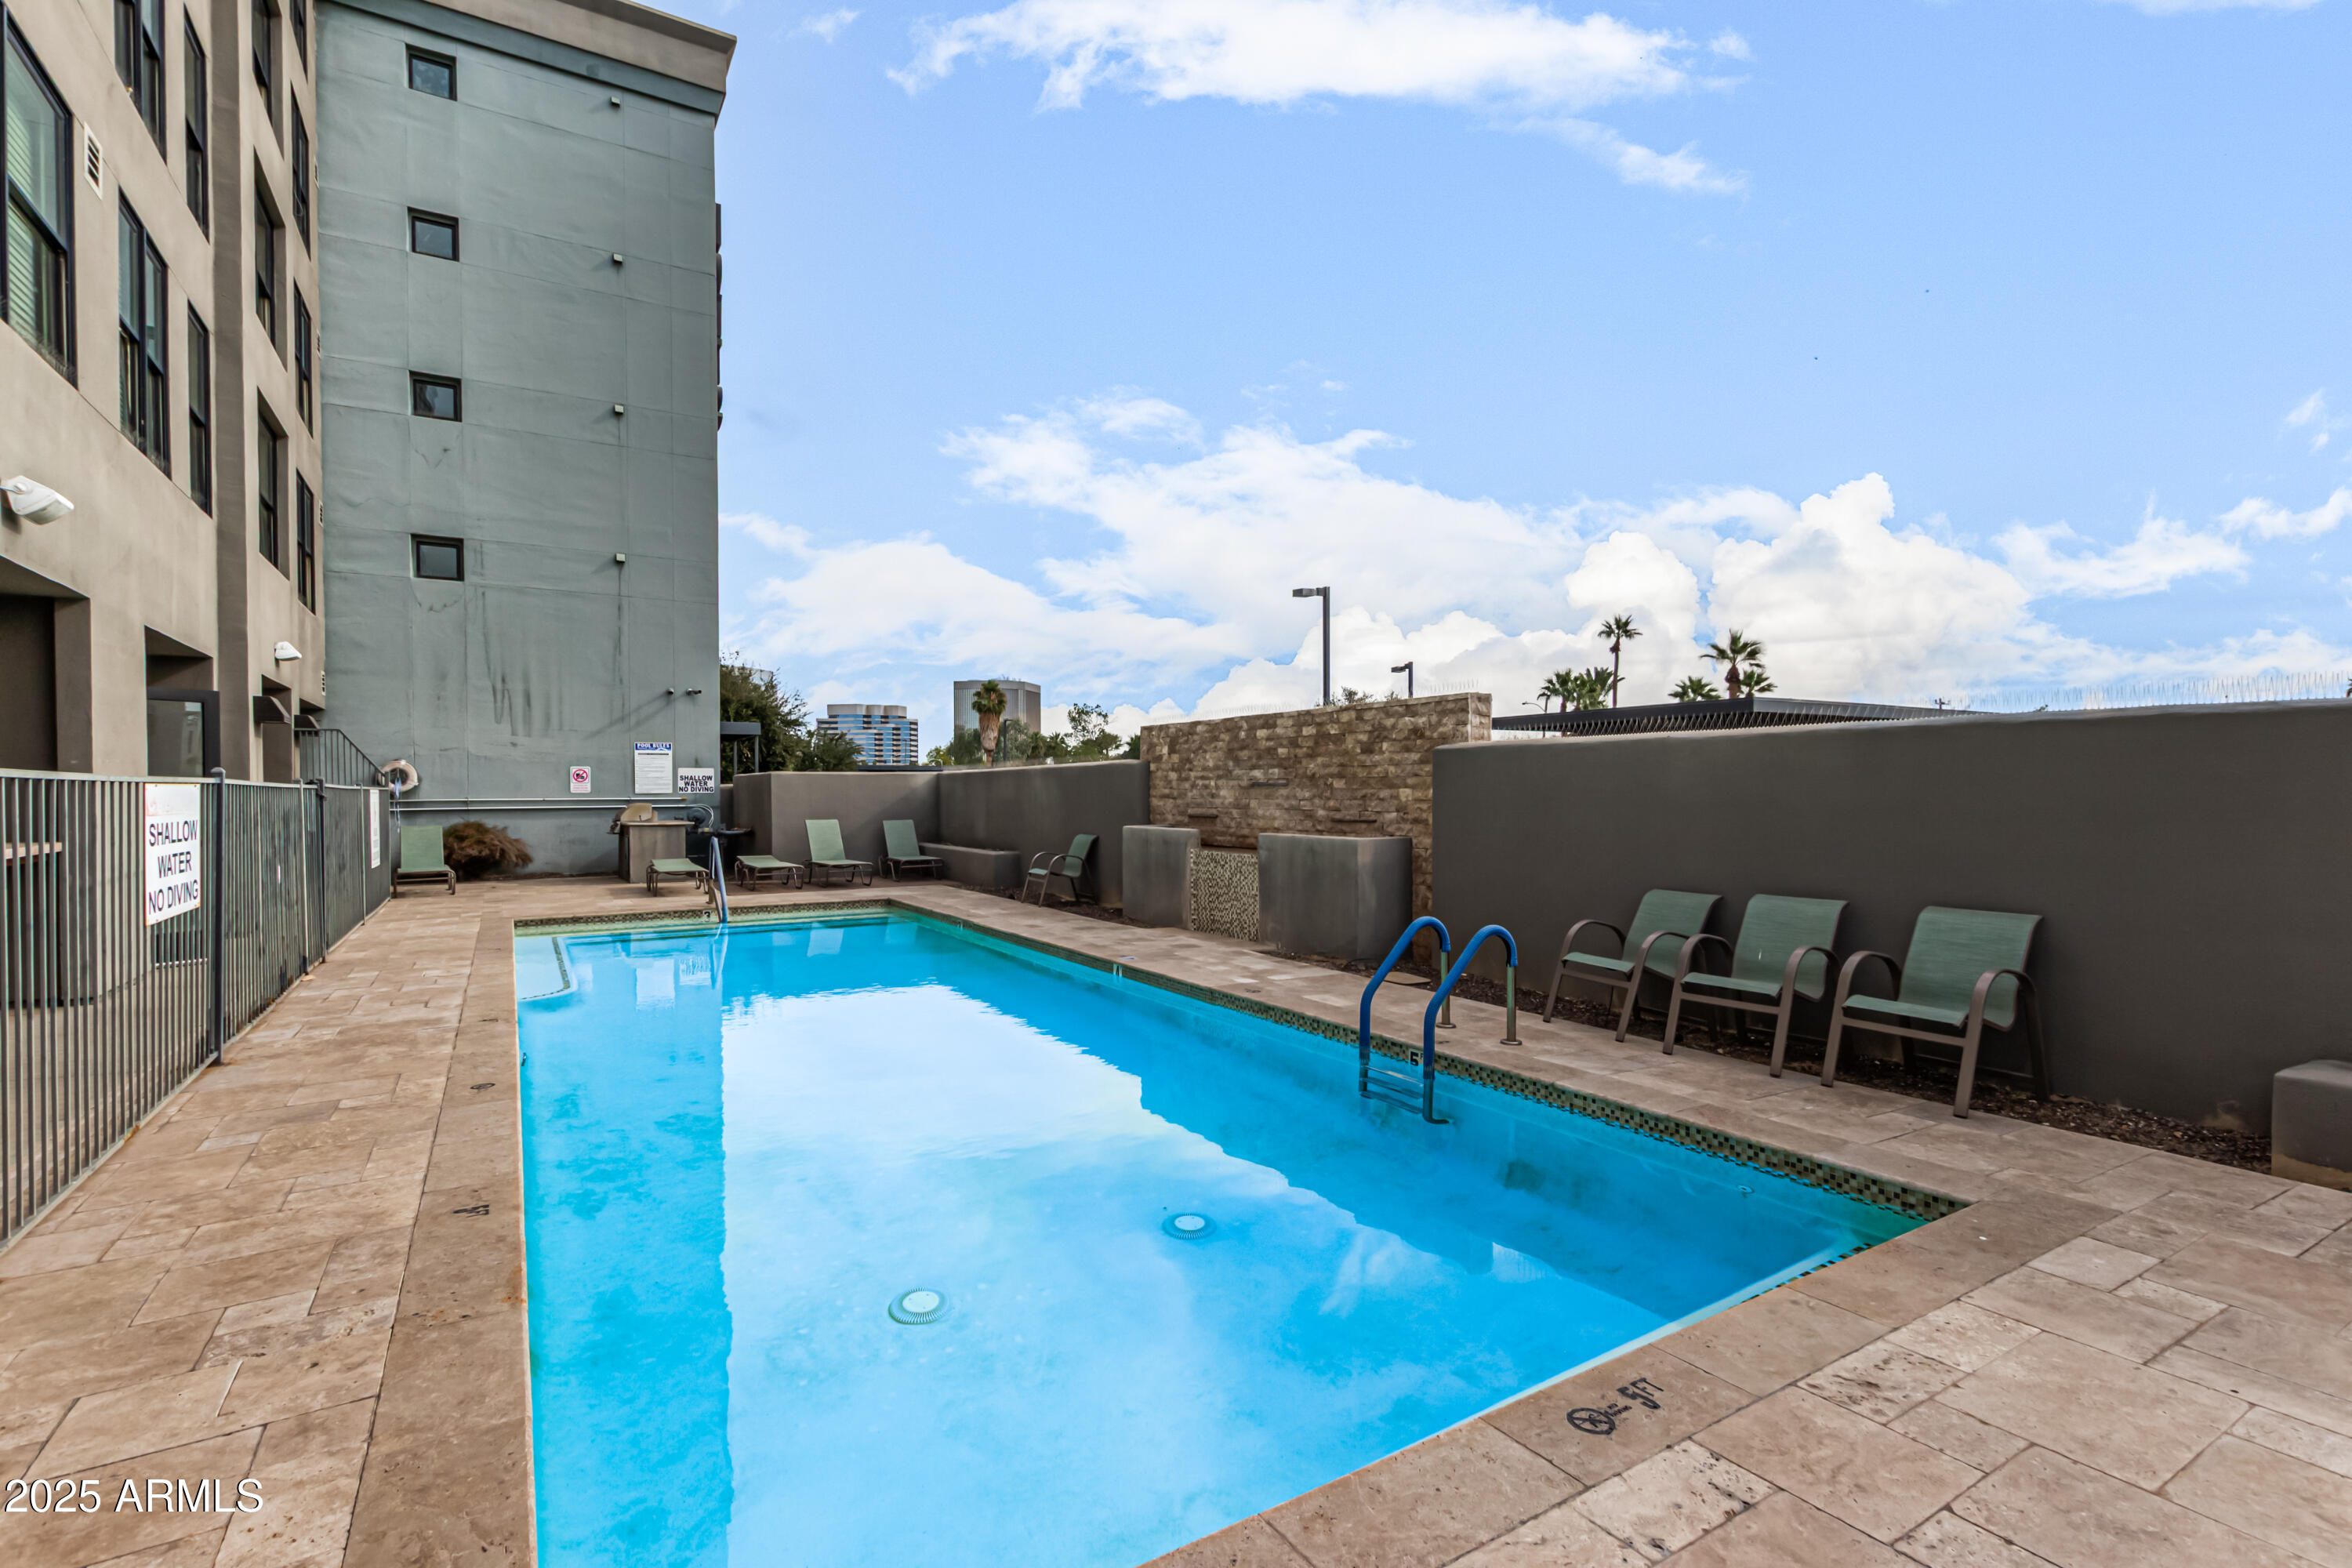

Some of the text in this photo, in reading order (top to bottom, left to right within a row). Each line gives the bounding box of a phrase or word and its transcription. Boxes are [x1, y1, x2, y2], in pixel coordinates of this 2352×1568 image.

[149, 820, 198, 847] SHALLOW
[158, 851, 192, 879] WATER
[148, 879, 198, 915] NO DIVING
